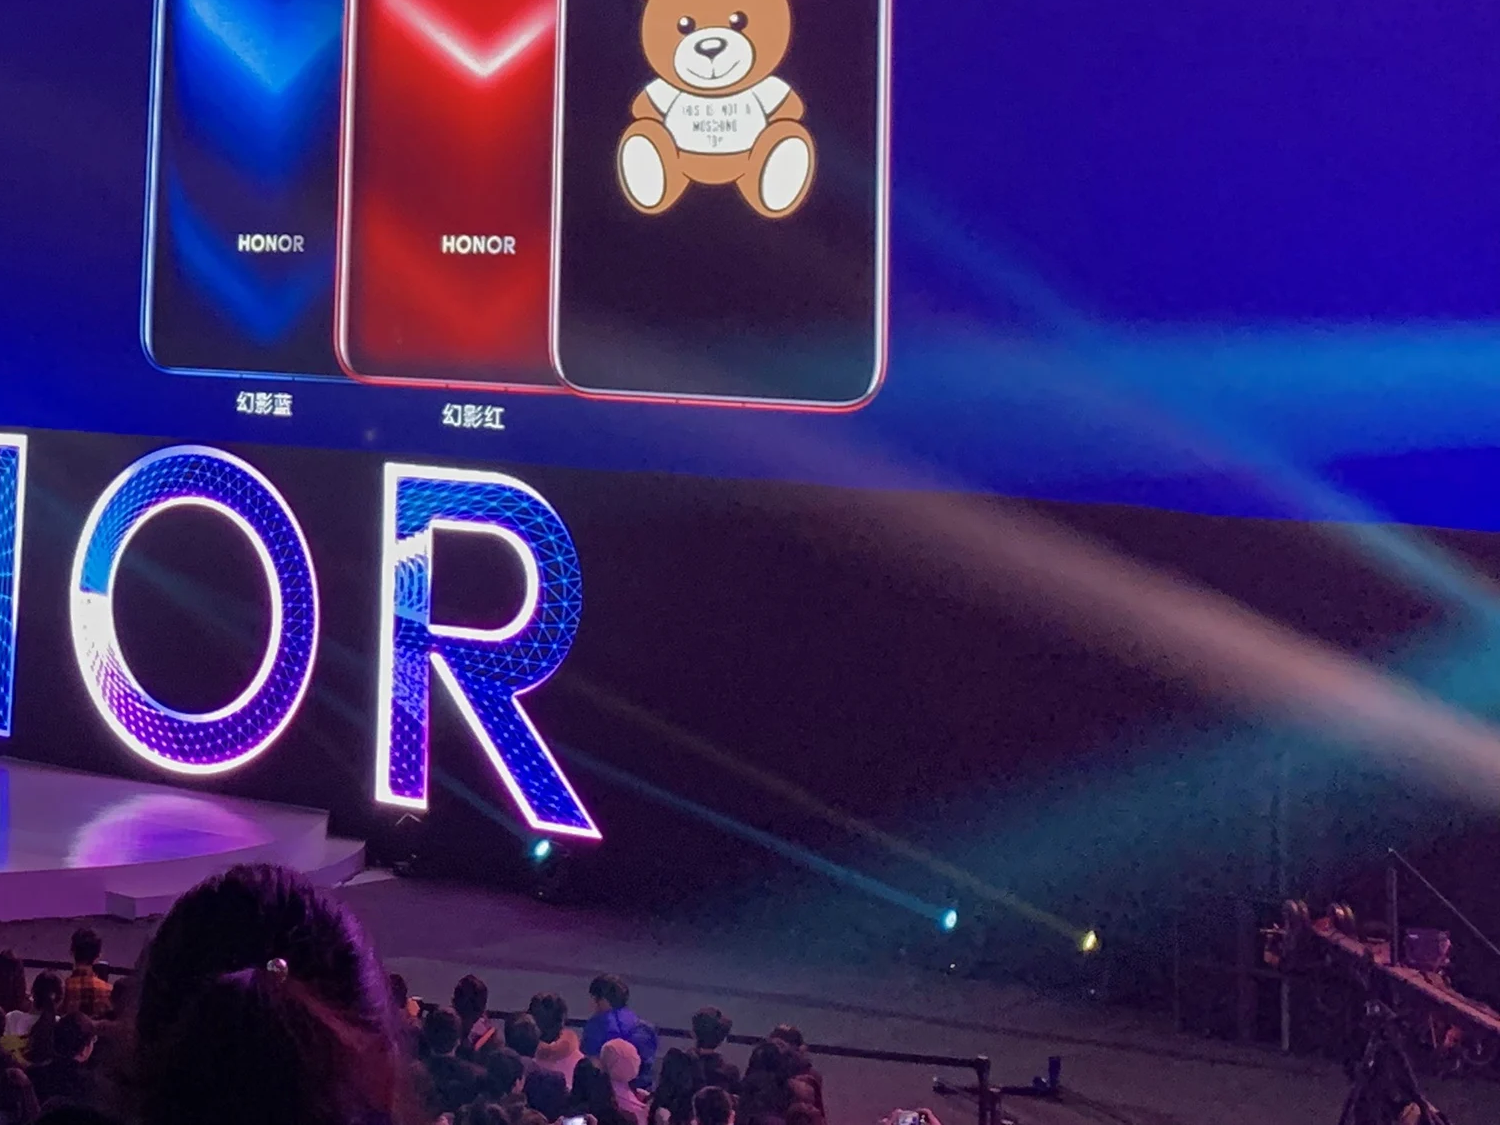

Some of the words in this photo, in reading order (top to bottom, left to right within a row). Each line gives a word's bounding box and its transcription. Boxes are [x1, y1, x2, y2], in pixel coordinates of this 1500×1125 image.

[237, 234, 305, 253] HONOR
[441, 235, 517, 255] HONOR
[236, 391, 293, 416] 幻影蓝
[442, 403, 505, 430] 幻影红
